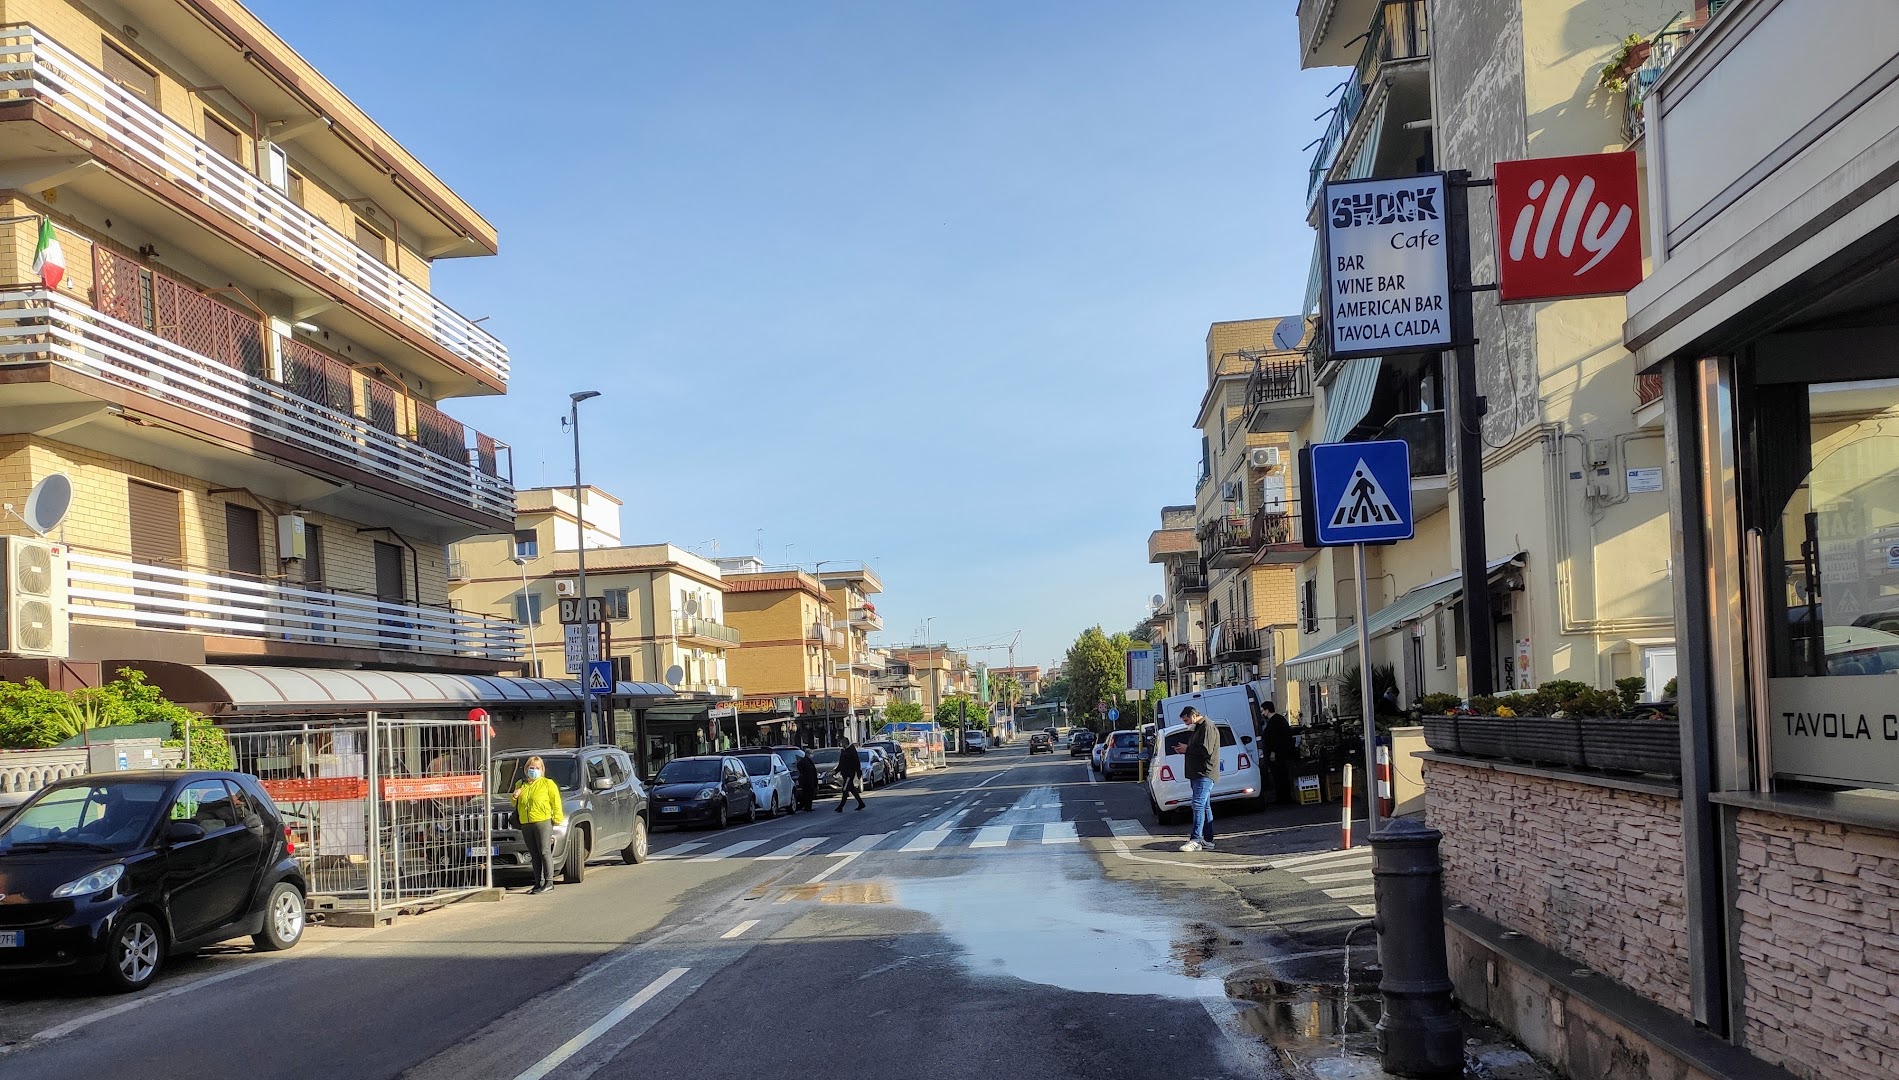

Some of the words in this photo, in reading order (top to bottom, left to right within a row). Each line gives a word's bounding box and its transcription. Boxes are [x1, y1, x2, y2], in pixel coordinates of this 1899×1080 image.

[1332, 187, 1440, 229] SHOCK
[1509, 174, 1632, 276] illy
[1390, 229, 1440, 250] Cafe
[1337, 254, 1365, 272] BAR
[1337, 277, 1374, 295] WINE
[1378, 275, 1406, 292] BAR
[1336, 297, 1411, 319] AMERICAN
[1415, 295, 1443, 312] BAR
[1337, 322, 1391, 342] TAVOLA
[1394, 318, 1441, 337] CALDA
[570, 645, 594, 653] PIZZIA
[1783, 712, 1871, 740] TAVOLA
